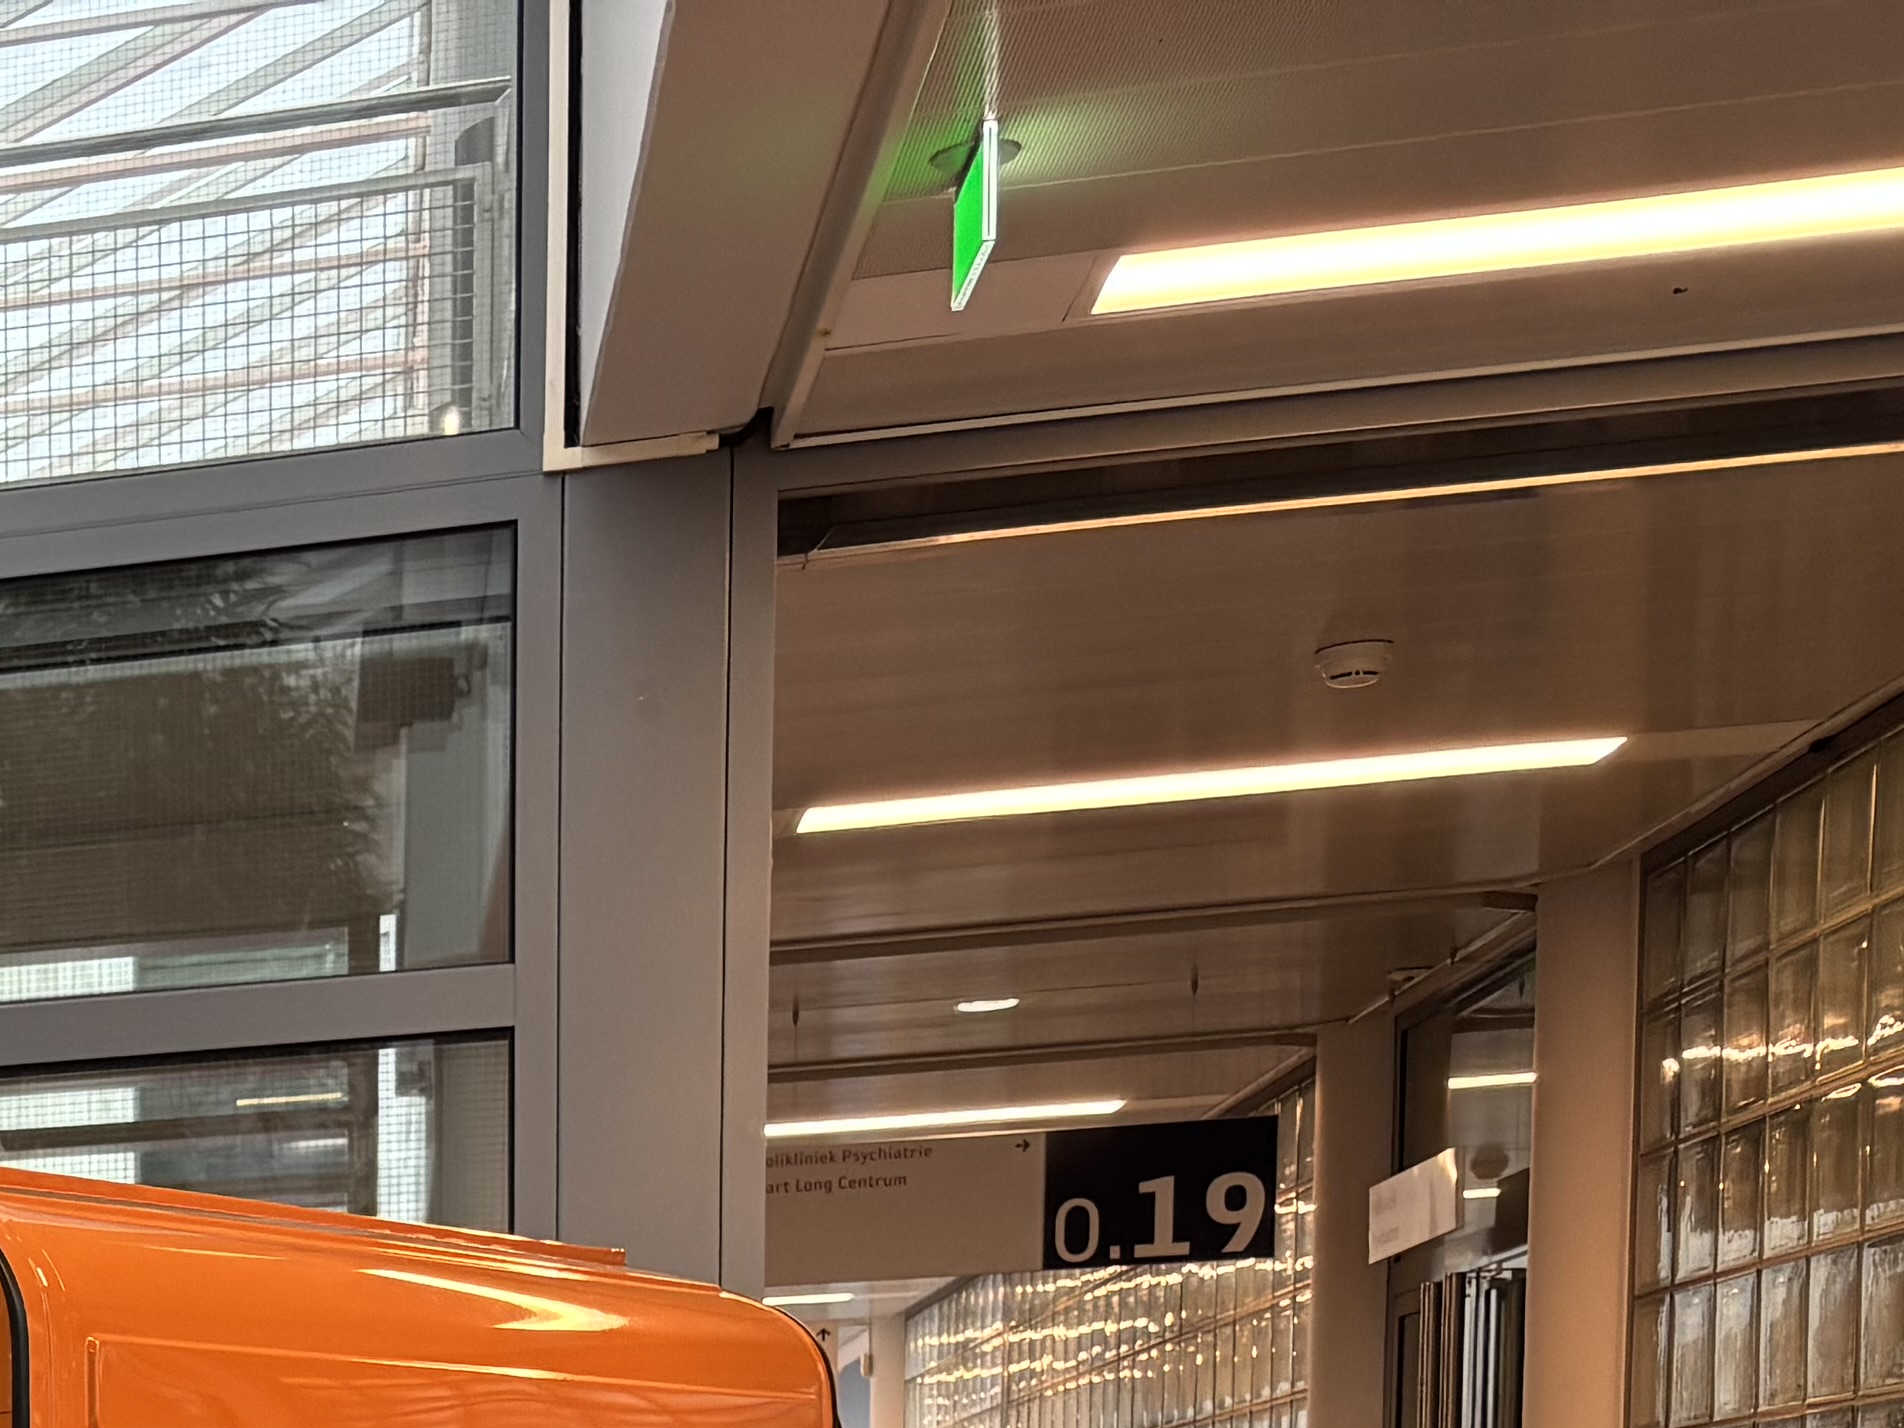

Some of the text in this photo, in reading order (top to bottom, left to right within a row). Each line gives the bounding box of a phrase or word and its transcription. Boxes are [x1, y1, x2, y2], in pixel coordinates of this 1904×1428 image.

[766, 1145, 933, 1168] olikliniek Psychiatrie
[766, 1175, 908, 1194] art Long Centrum
[1053, 1171, 1266, 1264] 0.19
